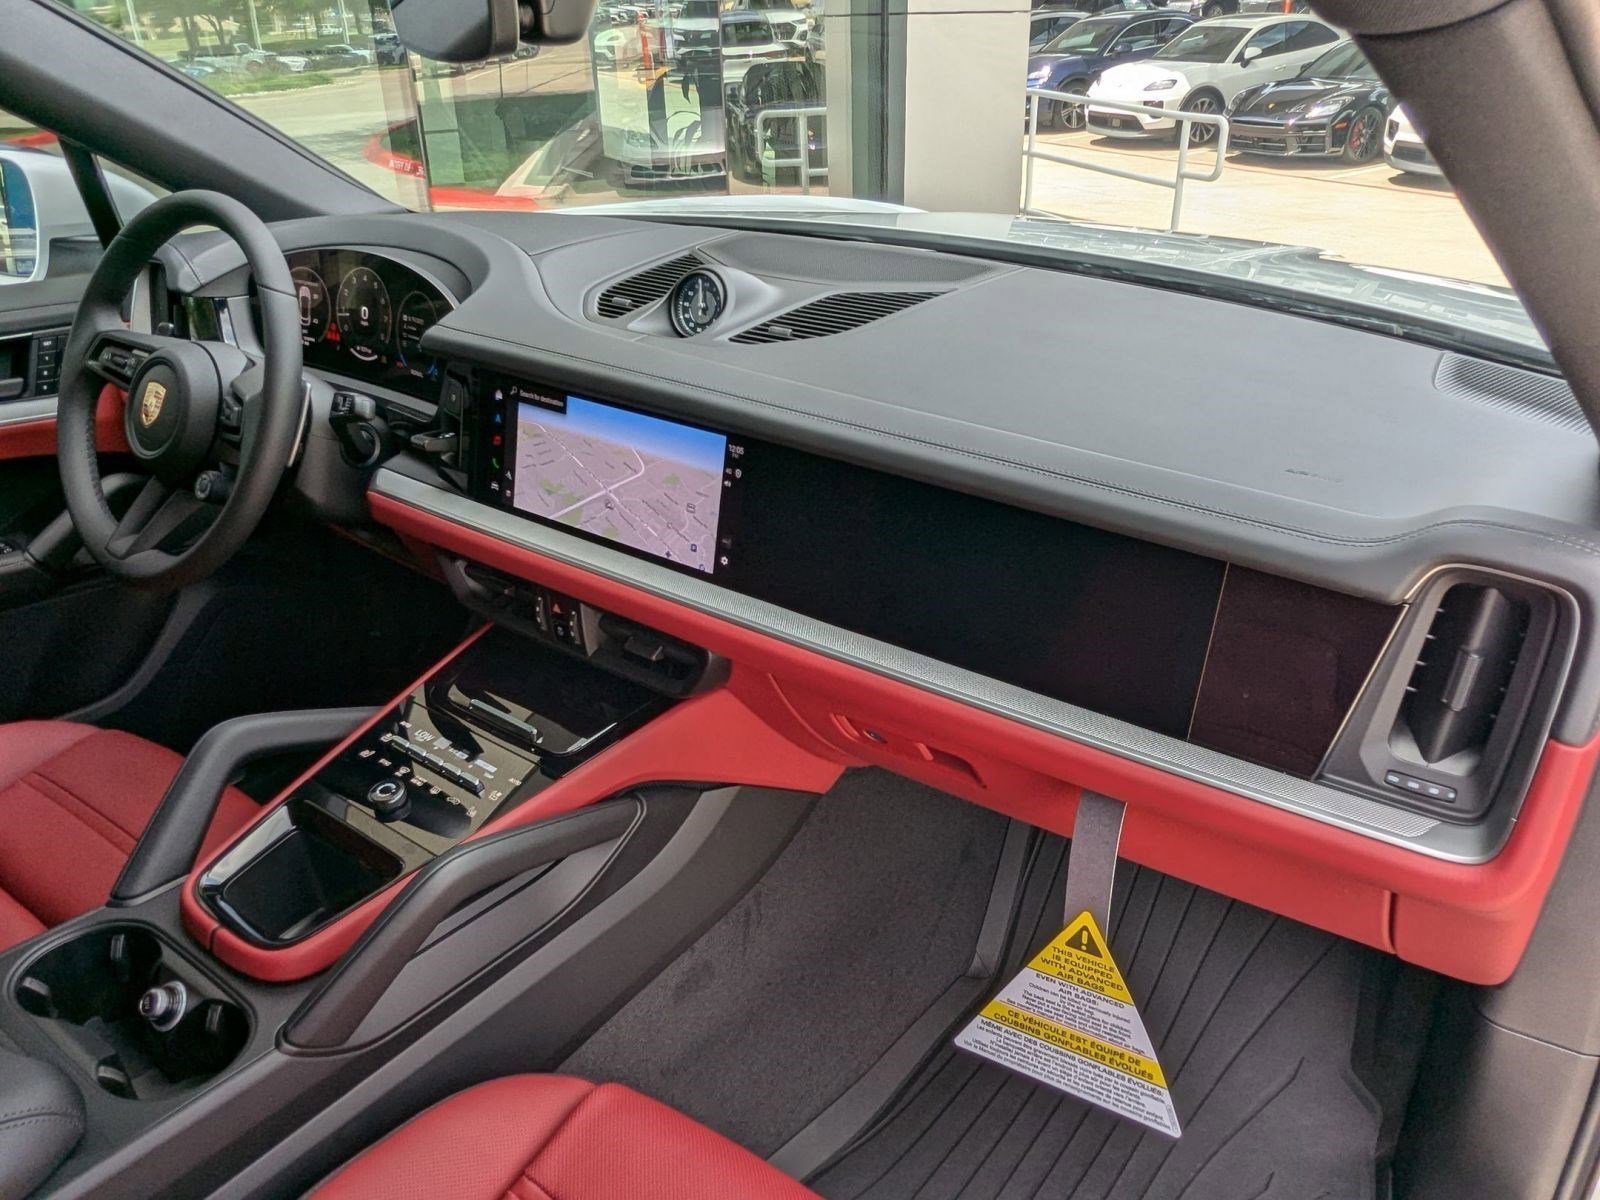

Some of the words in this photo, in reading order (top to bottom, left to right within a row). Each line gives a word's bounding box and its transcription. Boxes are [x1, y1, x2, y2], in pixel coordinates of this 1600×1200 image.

[360, 306, 369, 320] 0
[414, 729, 435, 742] LOW
[1052, 946, 1072, 957] THIS
[1075, 954, 1114, 972] VEHICLE
[1064, 958, 1113, 980] EQUIPPED
[1040, 957, 1065, 970] WITH
[1068, 967, 1123, 991] ADVANCED
[1056, 970, 1073, 980] AIR
[1077, 977, 1104, 992] BAGS
[1035, 973, 1055, 983] EVEN
[1057, 980, 1078, 991] WITH
[1080, 989, 1124, 1009] ADVANCED
[1058, 987, 1071, 996] AIR
[1074, 993, 1098, 1006] BAGS:
[993, 1012, 1040, 1036] COUSSINS
[1043, 1031, 1105, 1062] GONFLABLES
[1108, 1057, 1153, 1080] ÉVOLUÉS
[1007, 1009, 1019, 1019] CE
[1022, 1015, 1066, 1037] VÉHICULE
[1069, 1033, 1086, 1045] EST
[1090, 1041, 1124, 1060] ÉQUIPÉ
[1127, 1055, 1140, 1066] DE
[980, 1018, 1002, 1032] MÊME
[1004, 1028, 1022, 1039] AVEC
[1023, 1035, 1037, 1046] DES
[1039, 1042, 1075, 1061] COUSSINS
[1077, 1057, 1126, 1081] GONFLABLES
[1127, 1077, 1163, 1096] ÉVOLUÉS:
